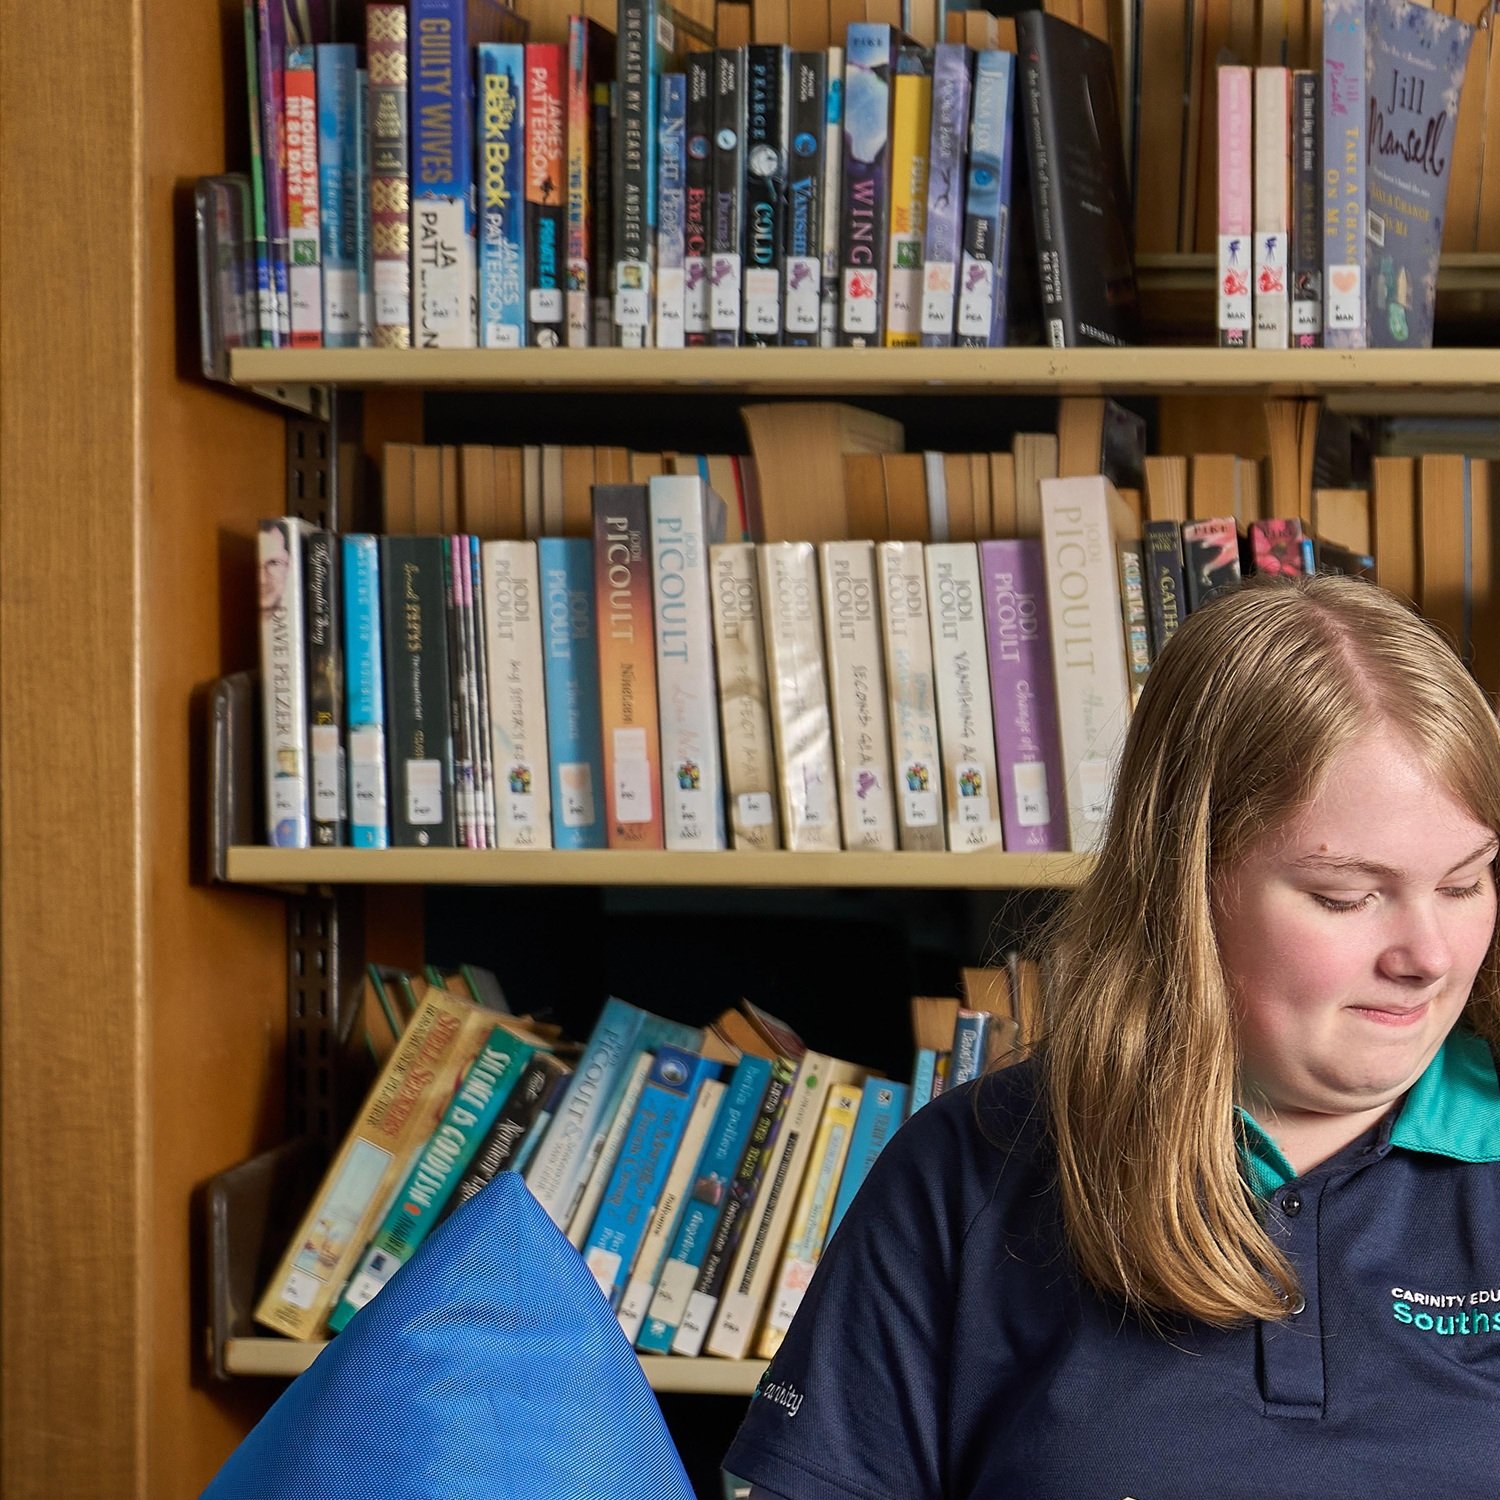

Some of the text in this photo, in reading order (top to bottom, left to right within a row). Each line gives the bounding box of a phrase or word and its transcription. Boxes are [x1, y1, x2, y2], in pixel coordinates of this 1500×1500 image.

[420, 18, 452, 185] GUILTY WIVES
[531, 67, 549, 187] PATTERSON
[547, 94, 563, 161] JAMES
[1387, 68, 1426, 115] Jill
[626, 119, 641, 172] HEART
[1366, 97, 1448, 178] Mansell
[754, 202, 774, 264] COLD
[604, 515, 634, 644] PICOULT
[657, 516, 689, 663] PICOULT
[994, 572, 1020, 665] PICOULT
[1053, 504, 1096, 675] PICOULT
[1390, 1286, 1467, 1309] CARINITY
